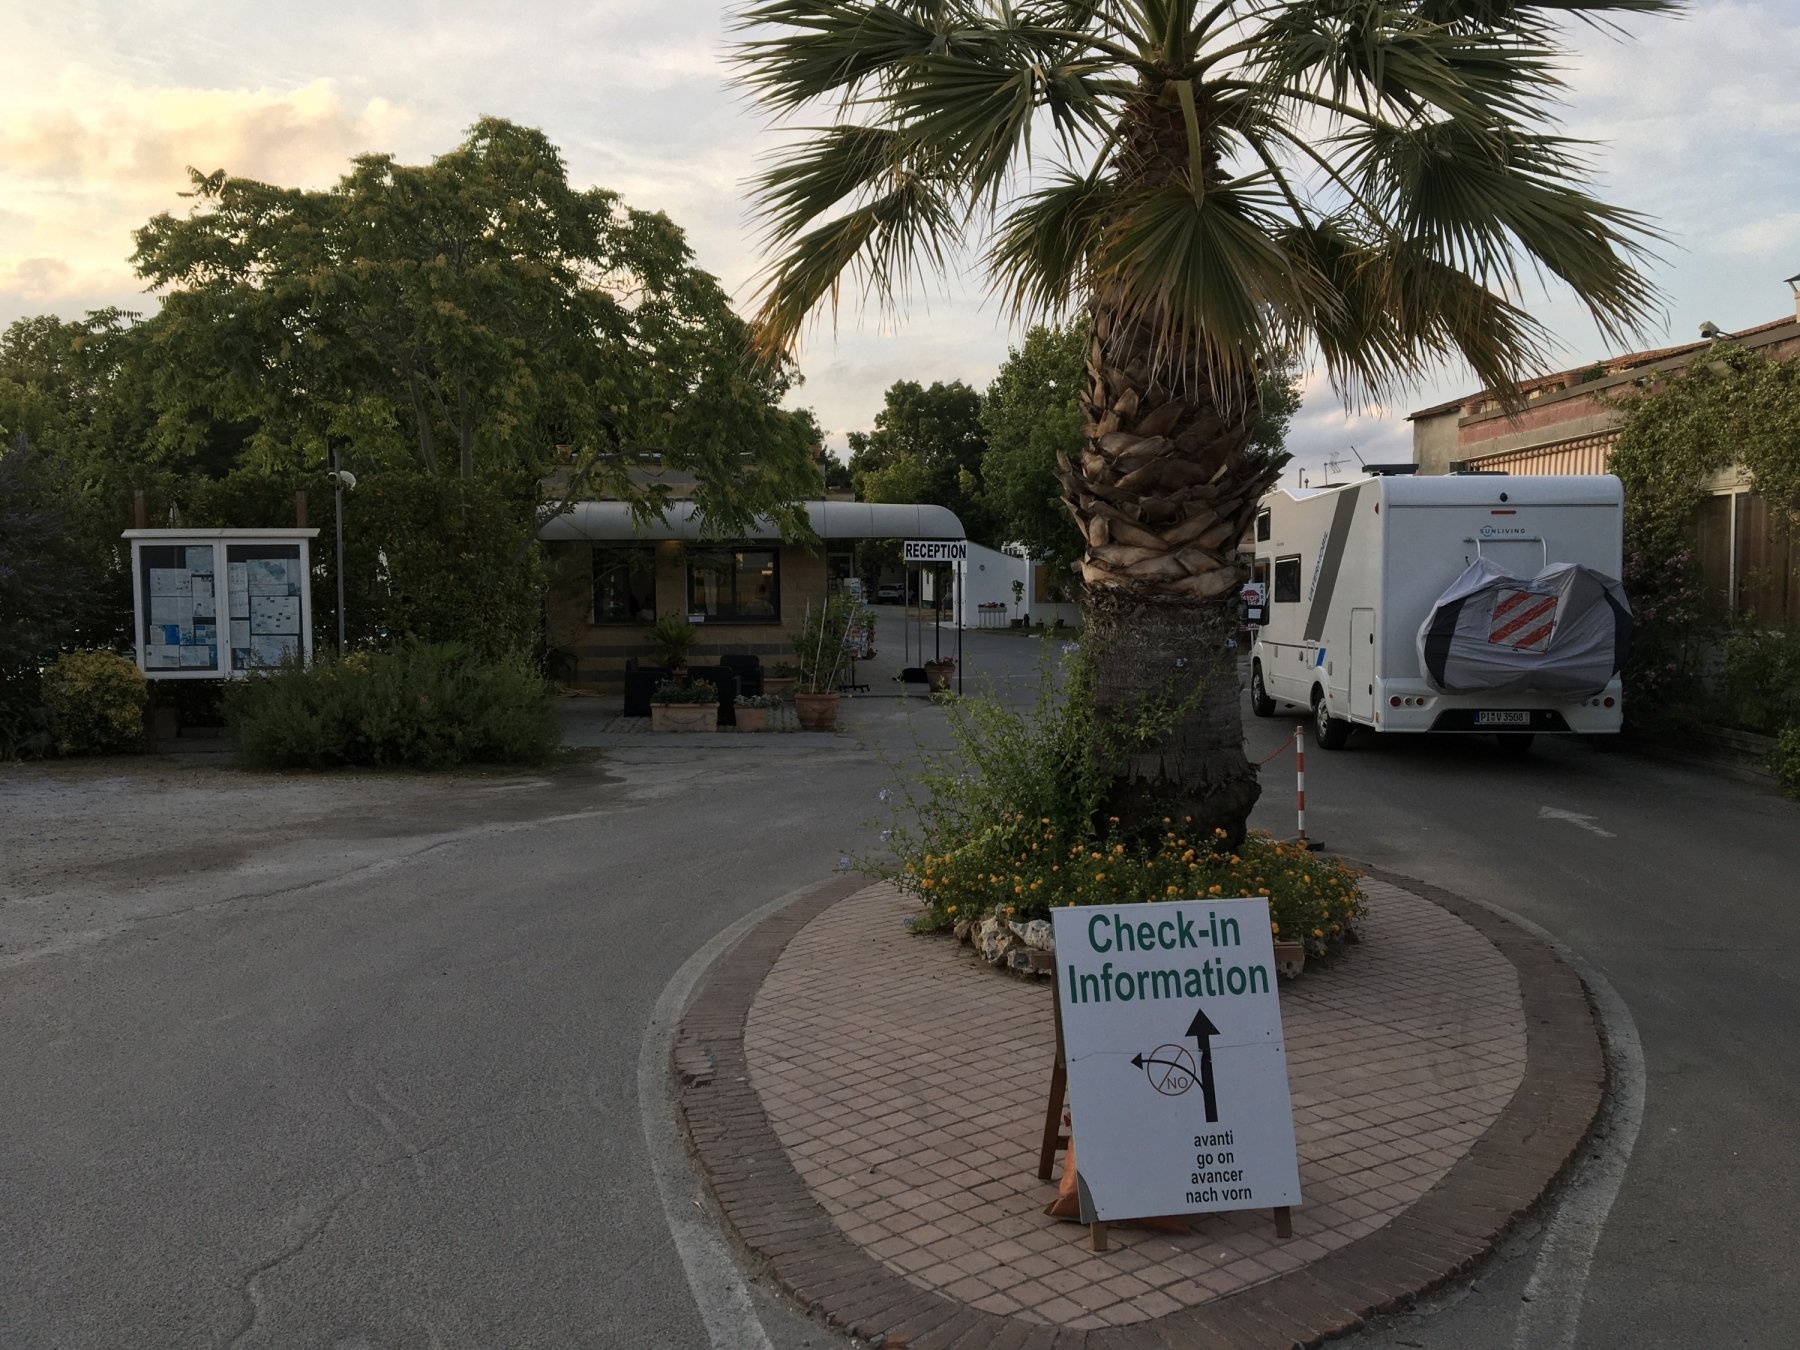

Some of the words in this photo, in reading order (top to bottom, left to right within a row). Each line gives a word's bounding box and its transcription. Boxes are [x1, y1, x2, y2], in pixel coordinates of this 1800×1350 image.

[1480, 525, 1526, 537] SUNLIVING
[905, 543, 967, 559] RECEPTION
[1503, 712, 1524, 722] 3508
[1088, 911, 1240, 953] Check-in
[1068, 957, 1269, 1004] Information
[1167, 1076, 1189, 1090] NO
[1193, 1130, 1234, 1147] avanti
[1196, 1153, 1214, 1169] go
[1217, 1152, 1235, 1164] on
[1190, 1169, 1244, 1185] avancer
[1185, 1187, 1219, 1204] nach
[1221, 1187, 1252, 1201] vorn
